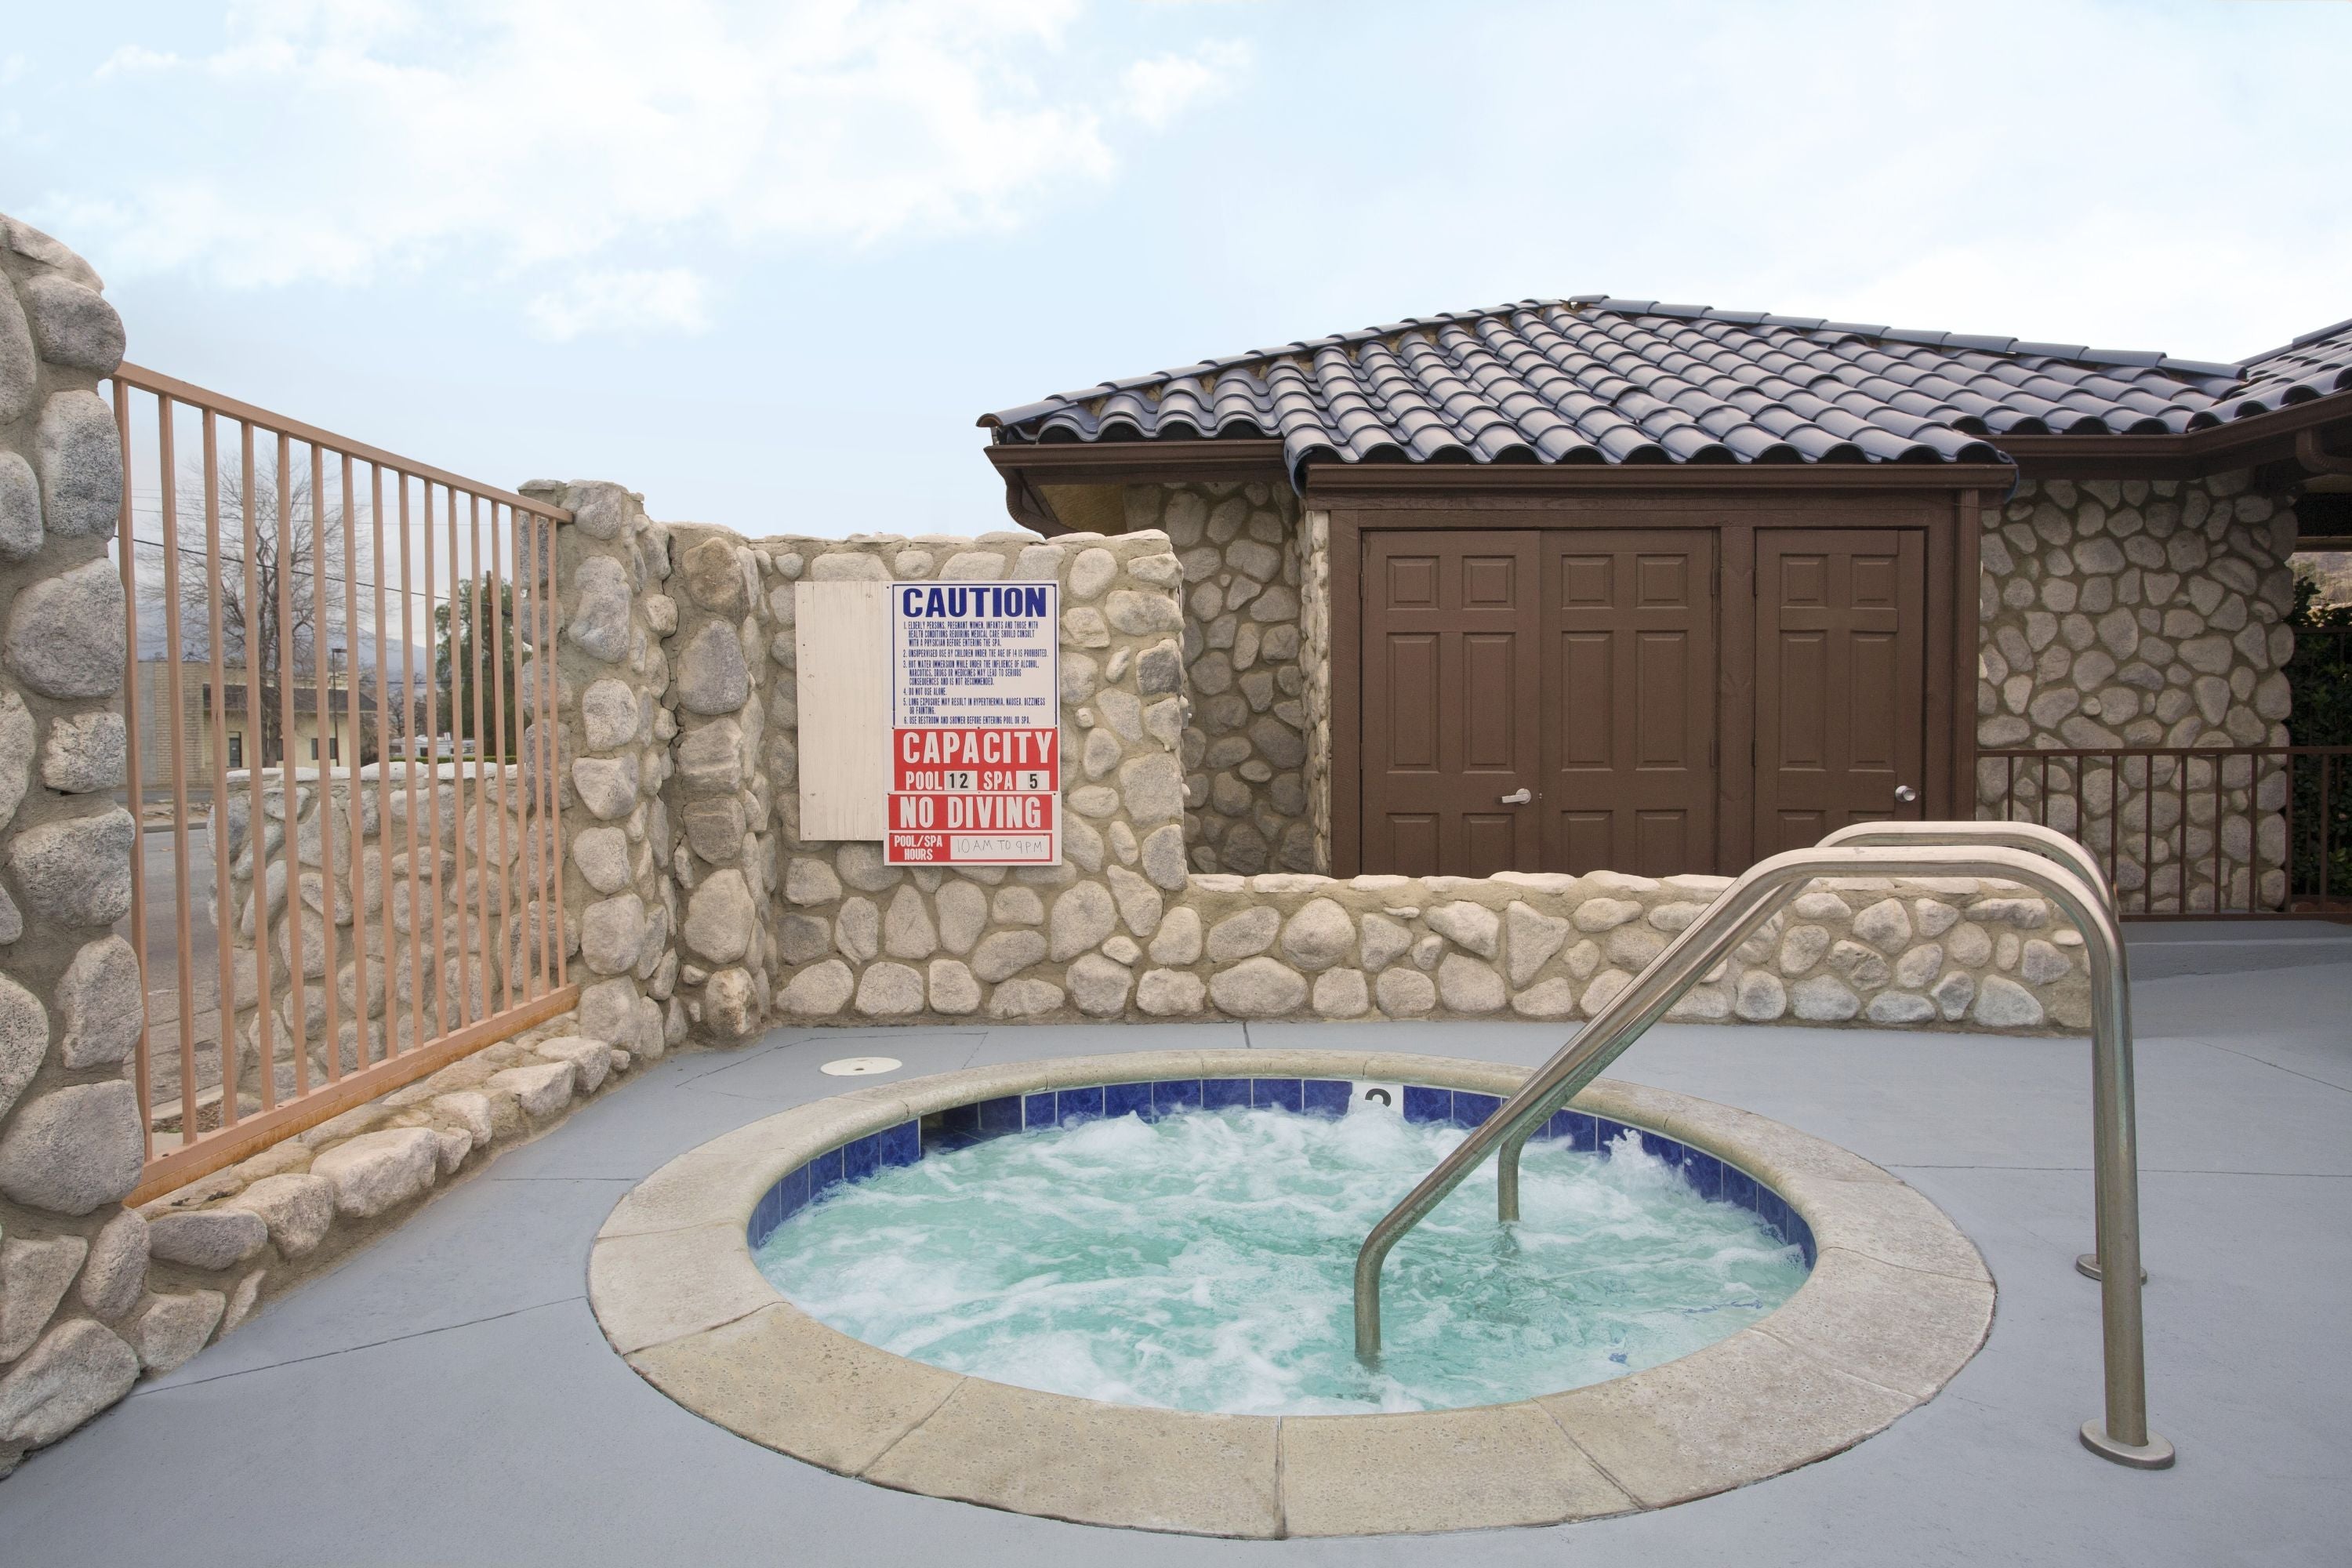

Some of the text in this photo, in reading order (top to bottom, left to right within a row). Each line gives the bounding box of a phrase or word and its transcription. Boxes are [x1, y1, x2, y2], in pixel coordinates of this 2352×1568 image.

[903, 588, 1047, 618] CAUTION
[909, 621, 925, 630] ELDERLY
[948, 621, 967, 630] PREGNANT
[1014, 621, 1026, 630] THOSE
[1029, 621, 1038, 630] WITH
[909, 630, 1034, 638] HEALTH CONDITIONS REQUIRING MEDICAL CARE SHOULD CONSULT
[909, 639, 919, 648] WITH
[924, 639, 946, 648] PHYSICIAN
[947, 639, 961, 648] BEFORE
[963, 639, 982, 648] ENTERING
[993, 639, 1001, 648] SPA.
[909, 649, 938, 658] UNSUPERVISED
[955, 649, 973, 658] CHILDREN
[975, 649, 987, 658] UNDER
[918, 660, 931, 669] WATER
[933, 660, 954, 669] IMMERSION
[956, 660, 967, 669] WHILE
[970, 660, 982, 669] UNDER
[993, 660, 1013, 669] INFLUENCE
[934, 669, 946, 677] DRUGS
[955, 669, 975, 677] MEDICINES
[977, 669, 985, 677] MAY
[987, 669, 996, 677] LEAD
[1005, 669, 1021, 677] SERIOUS
[909, 677, 938, 686] CONSEQUENCES
[964, 677, 994, 686] RECOMMENDED.
[934, 688, 947, 696] ALONE.
[909, 698, 919, 706] LONG
[920, 698, 940, 706] EXPOSURE
[952, 698, 966, 706] RESULT
[1024, 698, 1045, 706] DIZZINESS
[916, 706, 935, 715] FAINTING.
[918, 717, 939, 725] RESTROOM
[950, 717, 965, 725] SHOWER
[967, 717, 981, 725] BEFORE
[983, 717, 1002, 725] ENTERING
[1004, 717, 1012, 725] POOL
[1022, 717, 1030, 725] SPA.
[902, 731, 1053, 764] CAPACITY
[906, 771, 1038, 790] POOL 12 SPA 5
[900, 797, 1041, 829] NO DIVING
[894, 835, 942, 848] POOL/SPA
[997, 840, 1011, 850] TO
[904, 848, 933, 861] HOURS
